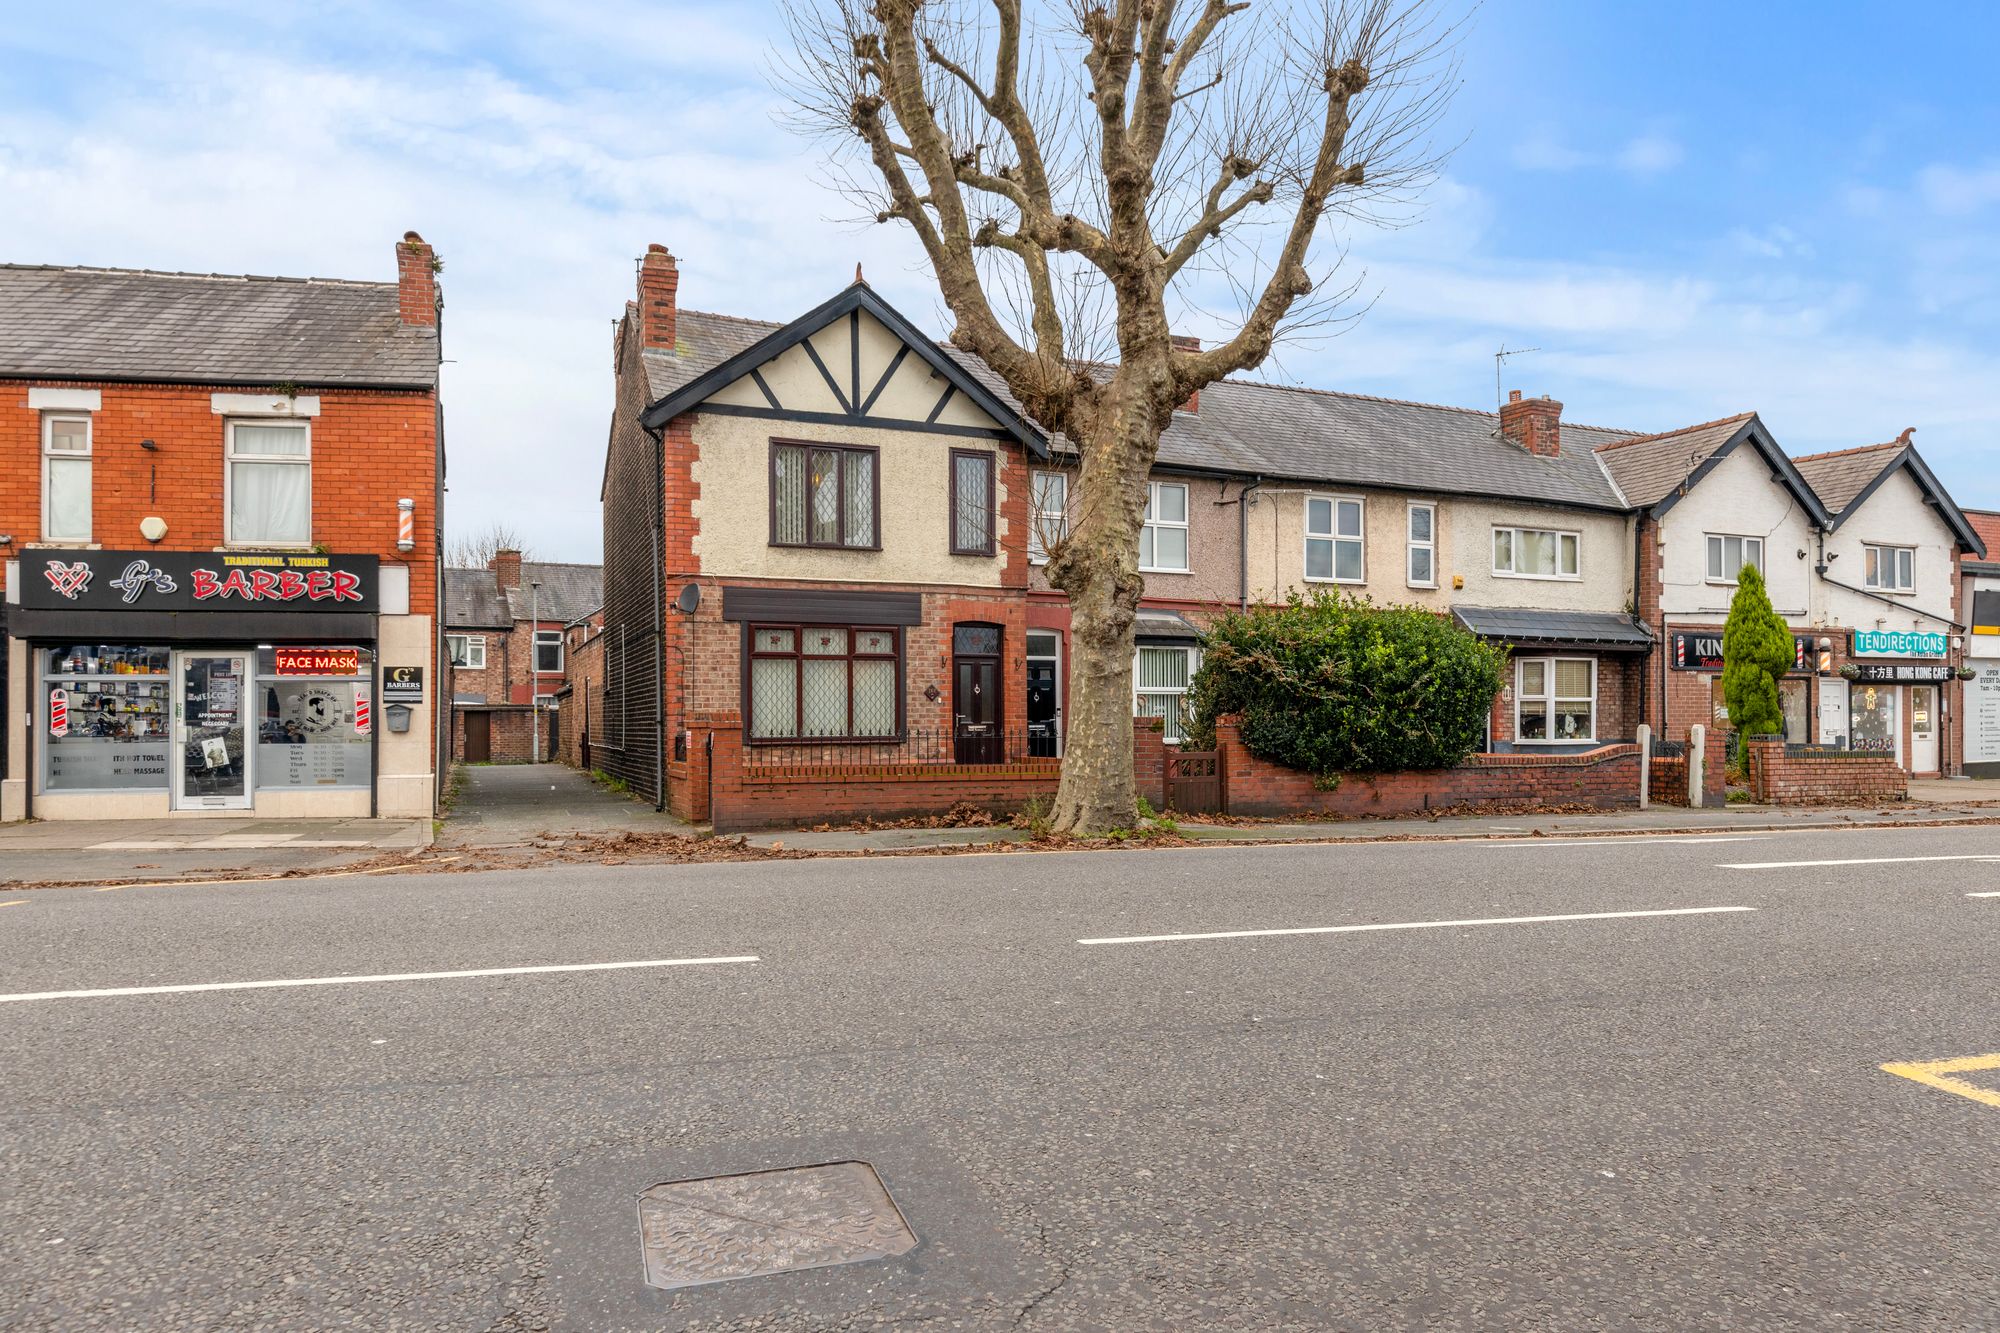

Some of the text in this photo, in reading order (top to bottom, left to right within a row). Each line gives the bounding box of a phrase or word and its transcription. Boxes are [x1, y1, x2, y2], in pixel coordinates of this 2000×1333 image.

[223, 556, 329, 567] TRADITIONAL TURKISH
[110, 560, 178, 602] G's
[191, 568, 363, 601] BARBER
[1859, 634, 1944, 651] TENDIRECTIONS
[279, 657, 356, 668] FACE MASK
[1870, 667, 1894, 679] 十方里
[1897, 667, 1948, 679] HONG KONG CAFE
[143, 754, 165, 762] TOWEL
[133, 767, 165, 775] MASSAGE
